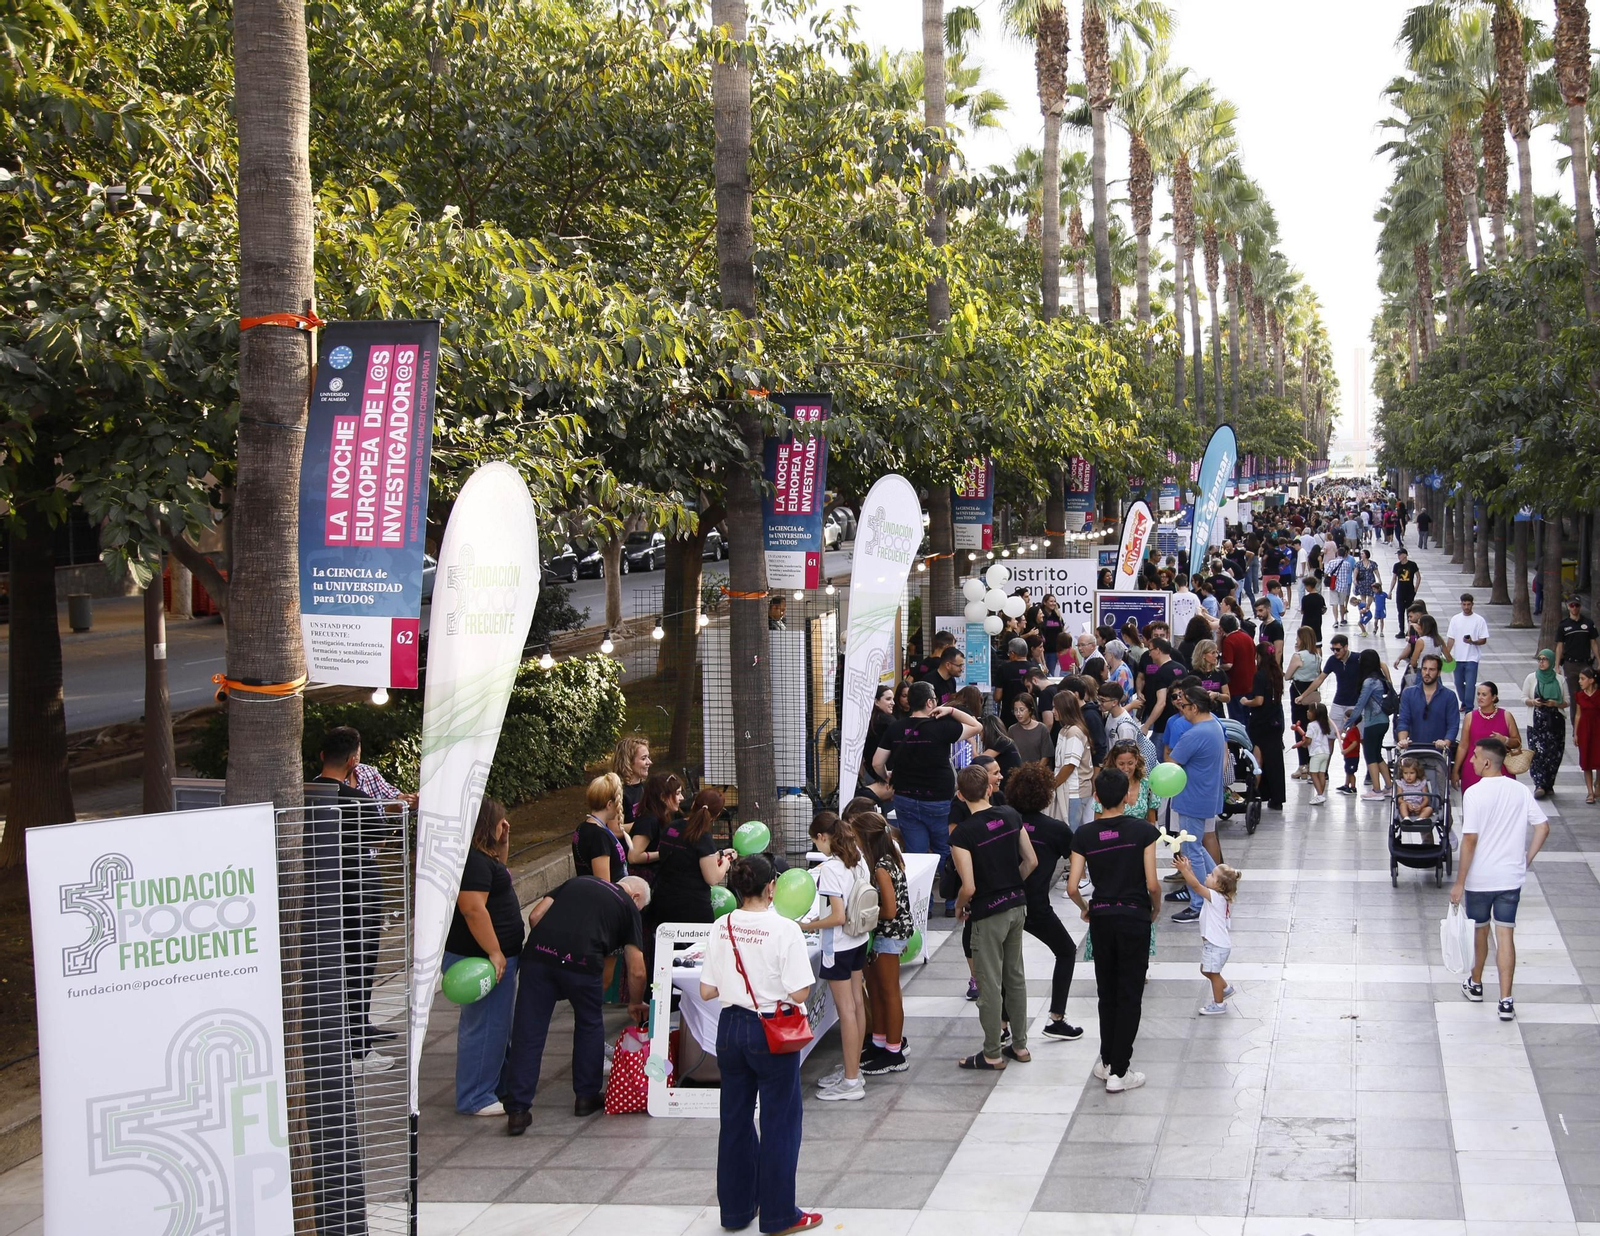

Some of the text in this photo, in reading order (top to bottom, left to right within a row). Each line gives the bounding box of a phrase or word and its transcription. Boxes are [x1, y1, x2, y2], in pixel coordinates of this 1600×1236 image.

[423, 350, 431, 358] TI
[422, 359, 430, 379] PARA
[420, 380, 428, 411] CIENCIA
[417, 413, 426, 439] HACEN
[355, 350, 390, 541] EUROPEA DE L@S
[382, 350, 414, 542] INVESTIGADOR@S
[416, 440, 425, 457] QUE
[329, 421, 355, 541] LA NOCHE
[413, 458, 423, 497] HOMBRES
[776, 447, 789, 512] LA NOCHE
[788, 456, 801, 512] EUROPEA
[1206, 451, 1229, 520] cajamar
[410, 505, 419, 542] MUJERES
[880, 520, 913, 539] FUNDACIÓN
[879, 532, 911, 552] POCO
[808, 558, 816, 566] 61
[877, 546, 910, 565] FRECUENTE
[313, 567, 388, 579] La CIENCIA de
[466, 562, 521, 588] FUNDACIÓN
[313, 581, 403, 592] tu UNIVERSIDAD
[313, 594, 374, 605] para TODOS
[311, 630, 350, 638] FRECUENTE:
[464, 612, 515, 635] FRECUENTE
[396, 631, 413, 645] 62
[312, 647, 337, 655] formación
[321, 656, 355, 664] enfermedades
[115, 864, 255, 910] FUNDACIÓN
[117, 895, 256, 943] POCO
[720, 934, 745, 943] Muum
[753, 937, 762, 945] Art
[731, 925, 770, 937] Metropolitan
[118, 927, 258, 971] FRECUENTE
[67, 964, 259, 998] fundacion@pocofrecuente.com
